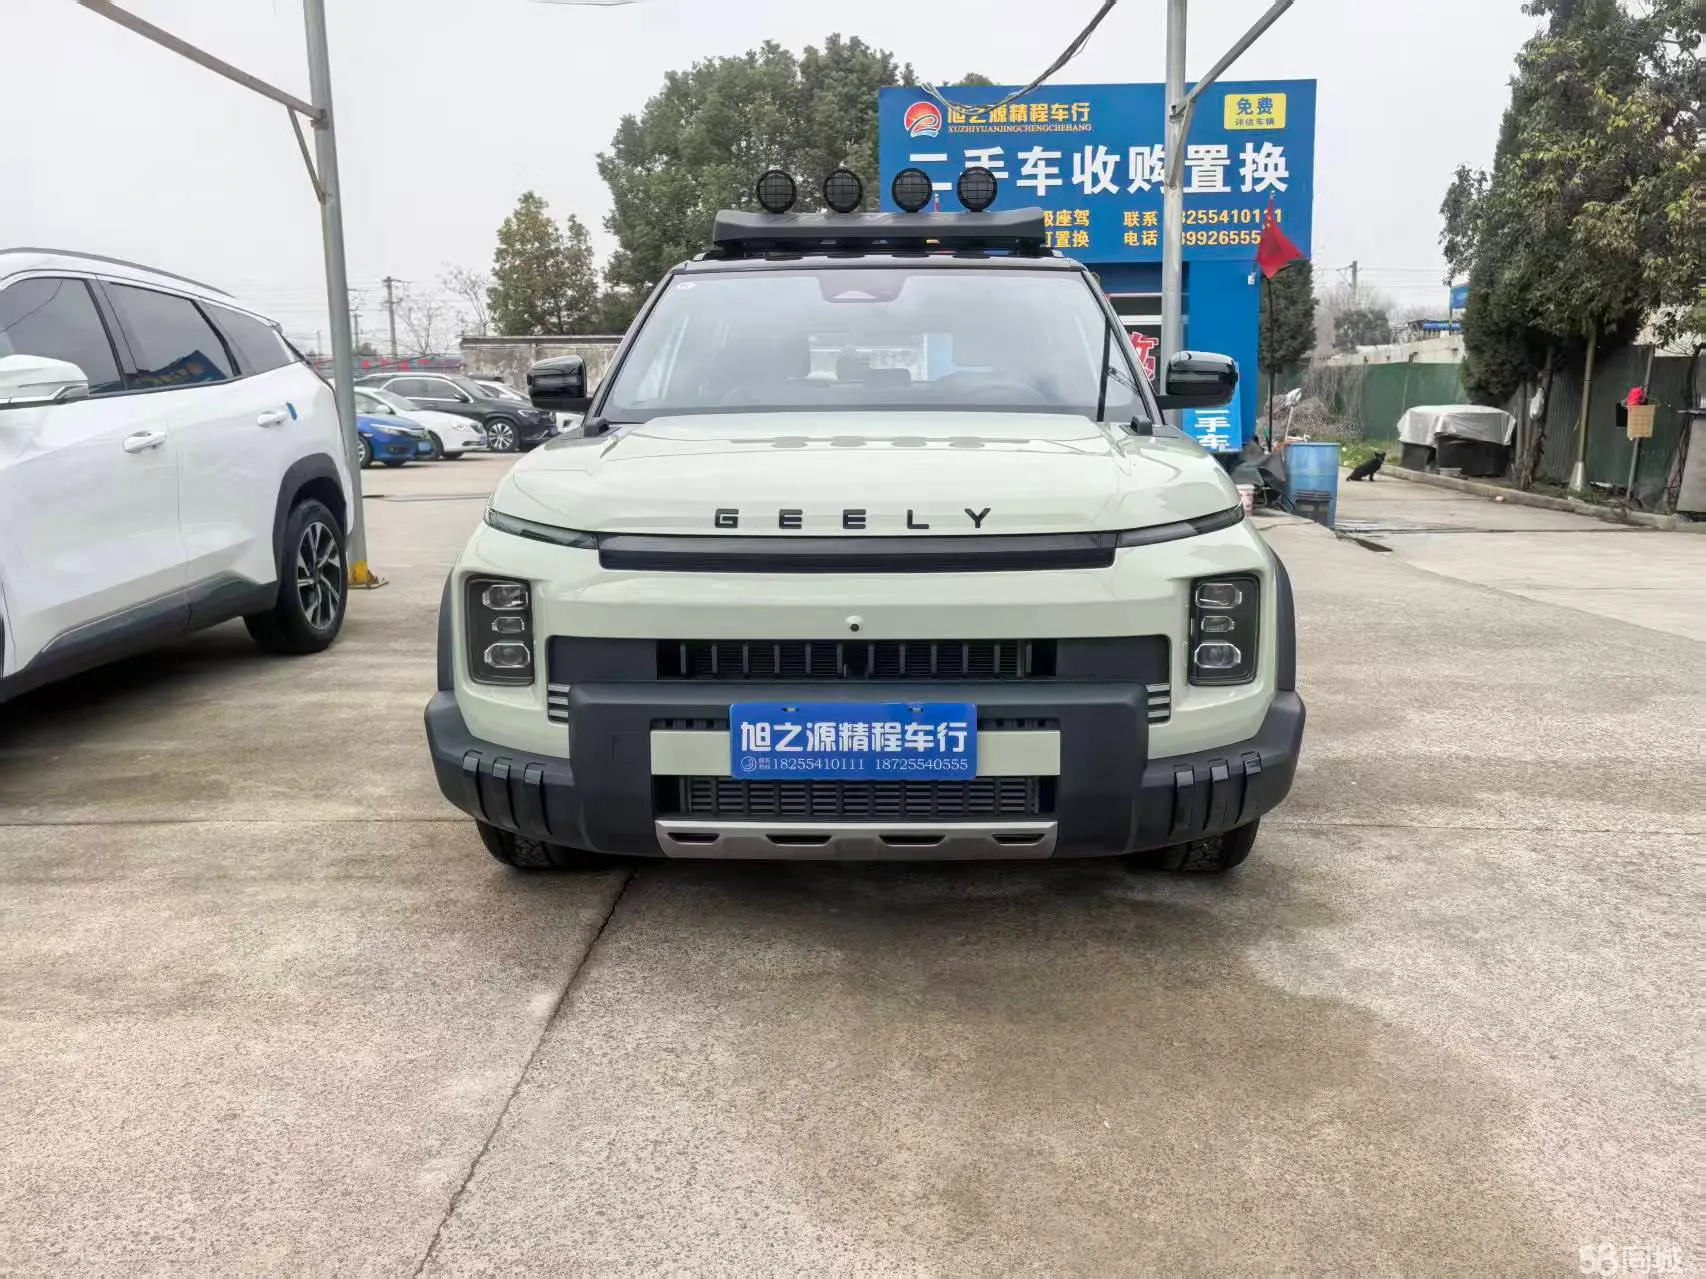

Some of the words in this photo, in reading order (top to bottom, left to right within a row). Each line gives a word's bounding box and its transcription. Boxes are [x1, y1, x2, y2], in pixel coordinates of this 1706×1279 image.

[1236, 97, 1274, 115] 免费
[1123, 210, 1159, 227] 联系
[1182, 208, 1283, 226] 25541011
[1123, 231, 1159, 247] 电话
[1181, 230, 1261, 246] 9926555
[714, 507, 992, 530] GEELY
[740, 721, 968, 754] 旭之源精程车行
[773, 757, 865, 771] 18255410111
[875, 757, 968, 771] 18725540555
